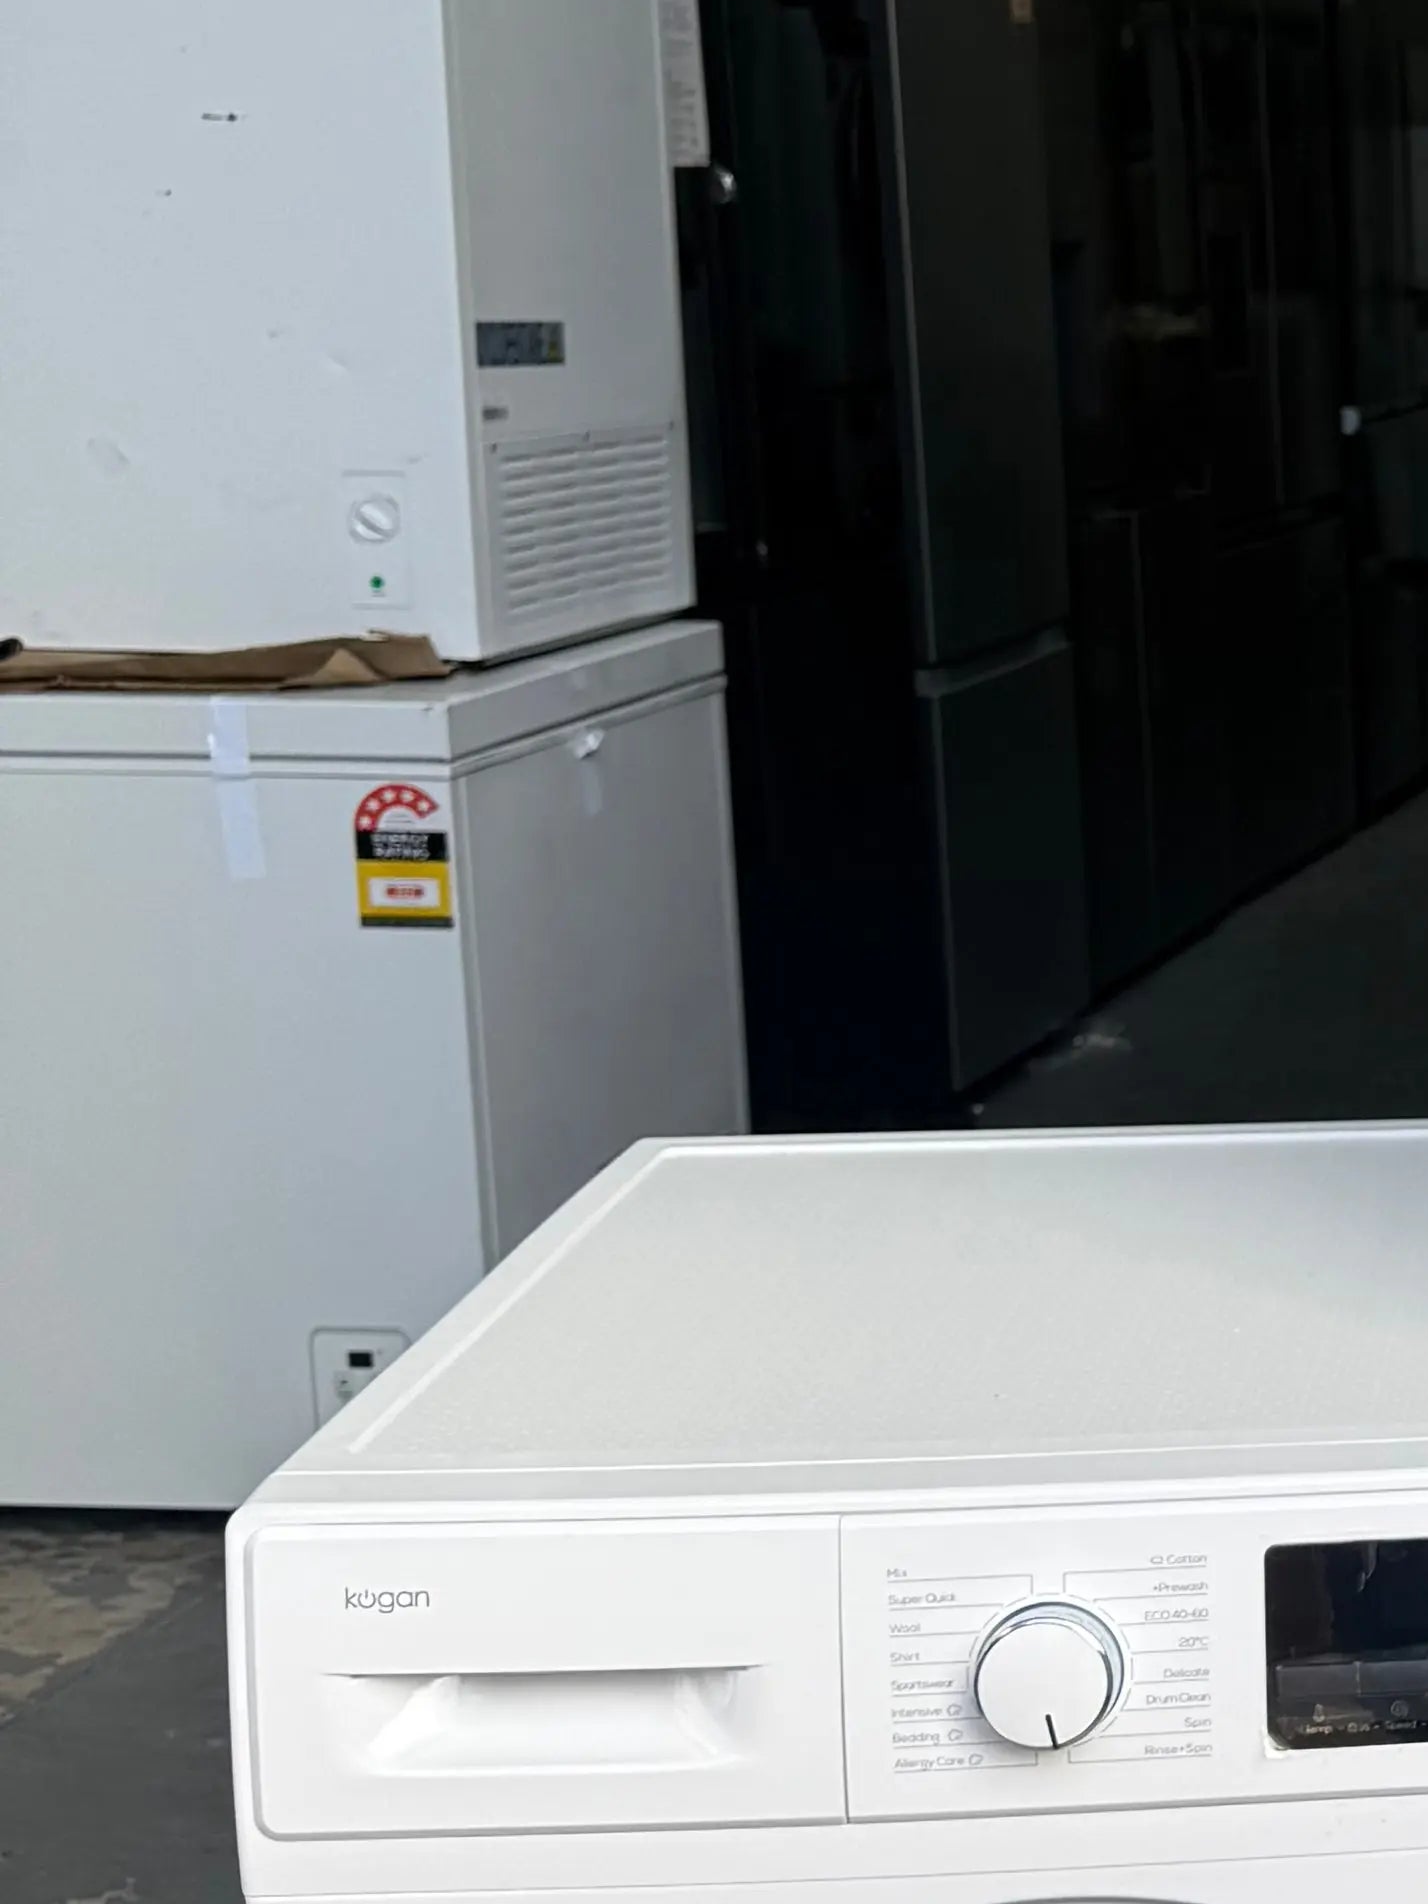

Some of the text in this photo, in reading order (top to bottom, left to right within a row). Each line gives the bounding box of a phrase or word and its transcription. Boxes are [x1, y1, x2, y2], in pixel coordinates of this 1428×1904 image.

[1166, 1553, 1207, 1565] Cotton
[345, 1586, 430, 1614] kogan
[888, 1593, 922, 1607] Super
[1144, 1609, 1171, 1621] ECO
[889, 1623, 921, 1634] Wool
[890, 1652, 920, 1663] Shirt
[1163, 1667, 1210, 1679] Delicate
[891, 1679, 954, 1692] Sportswear
[1146, 1692, 1212, 1705] Drum Clean
[891, 1707, 943, 1718] Intensive
[1184, 1716, 1212, 1728] Spin
[892, 1732, 941, 1746] Bedding
[894, 1756, 965, 1771] Allergy Care
